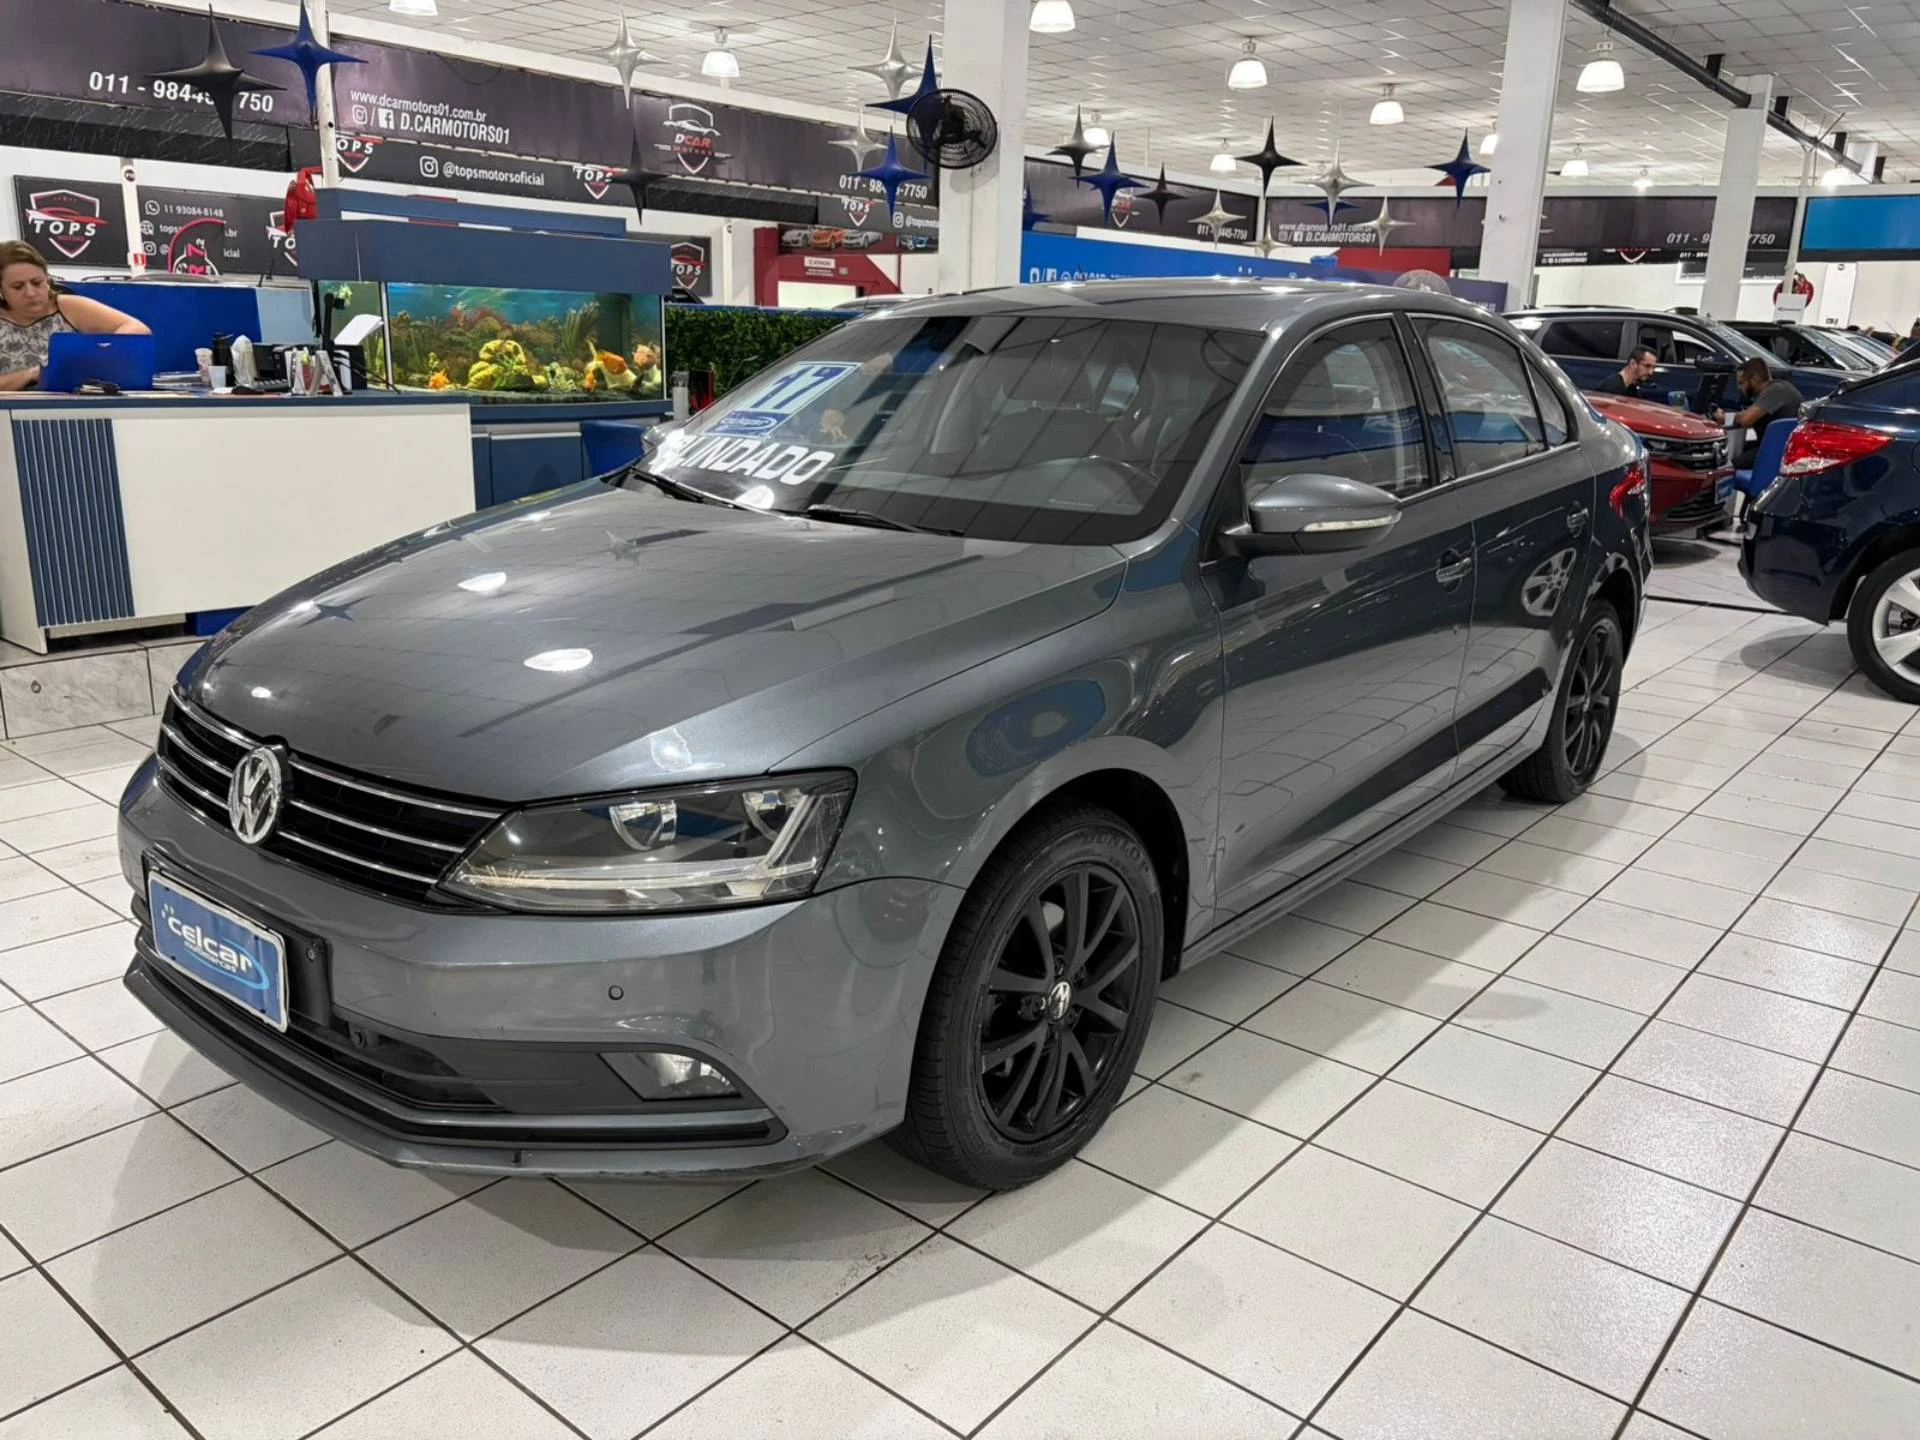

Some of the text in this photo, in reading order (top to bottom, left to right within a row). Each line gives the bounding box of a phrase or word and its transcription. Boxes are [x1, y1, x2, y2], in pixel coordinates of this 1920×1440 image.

[89, 71, 129, 94] 011
[350, 90, 487, 122] www.dcarmotors01.com.br
[400, 115, 511, 145] D.CARMOTORS01
[336, 138, 374, 154] OPS
[443, 162, 545, 186] @topsmotorsoficial
[839, 175, 858, 190] 011
[843, 201, 870, 213] TOPS
[33, 219, 96, 237] TOPS
[1666, 232, 1690, 244] 011
[167, 915, 253, 973] celcar
